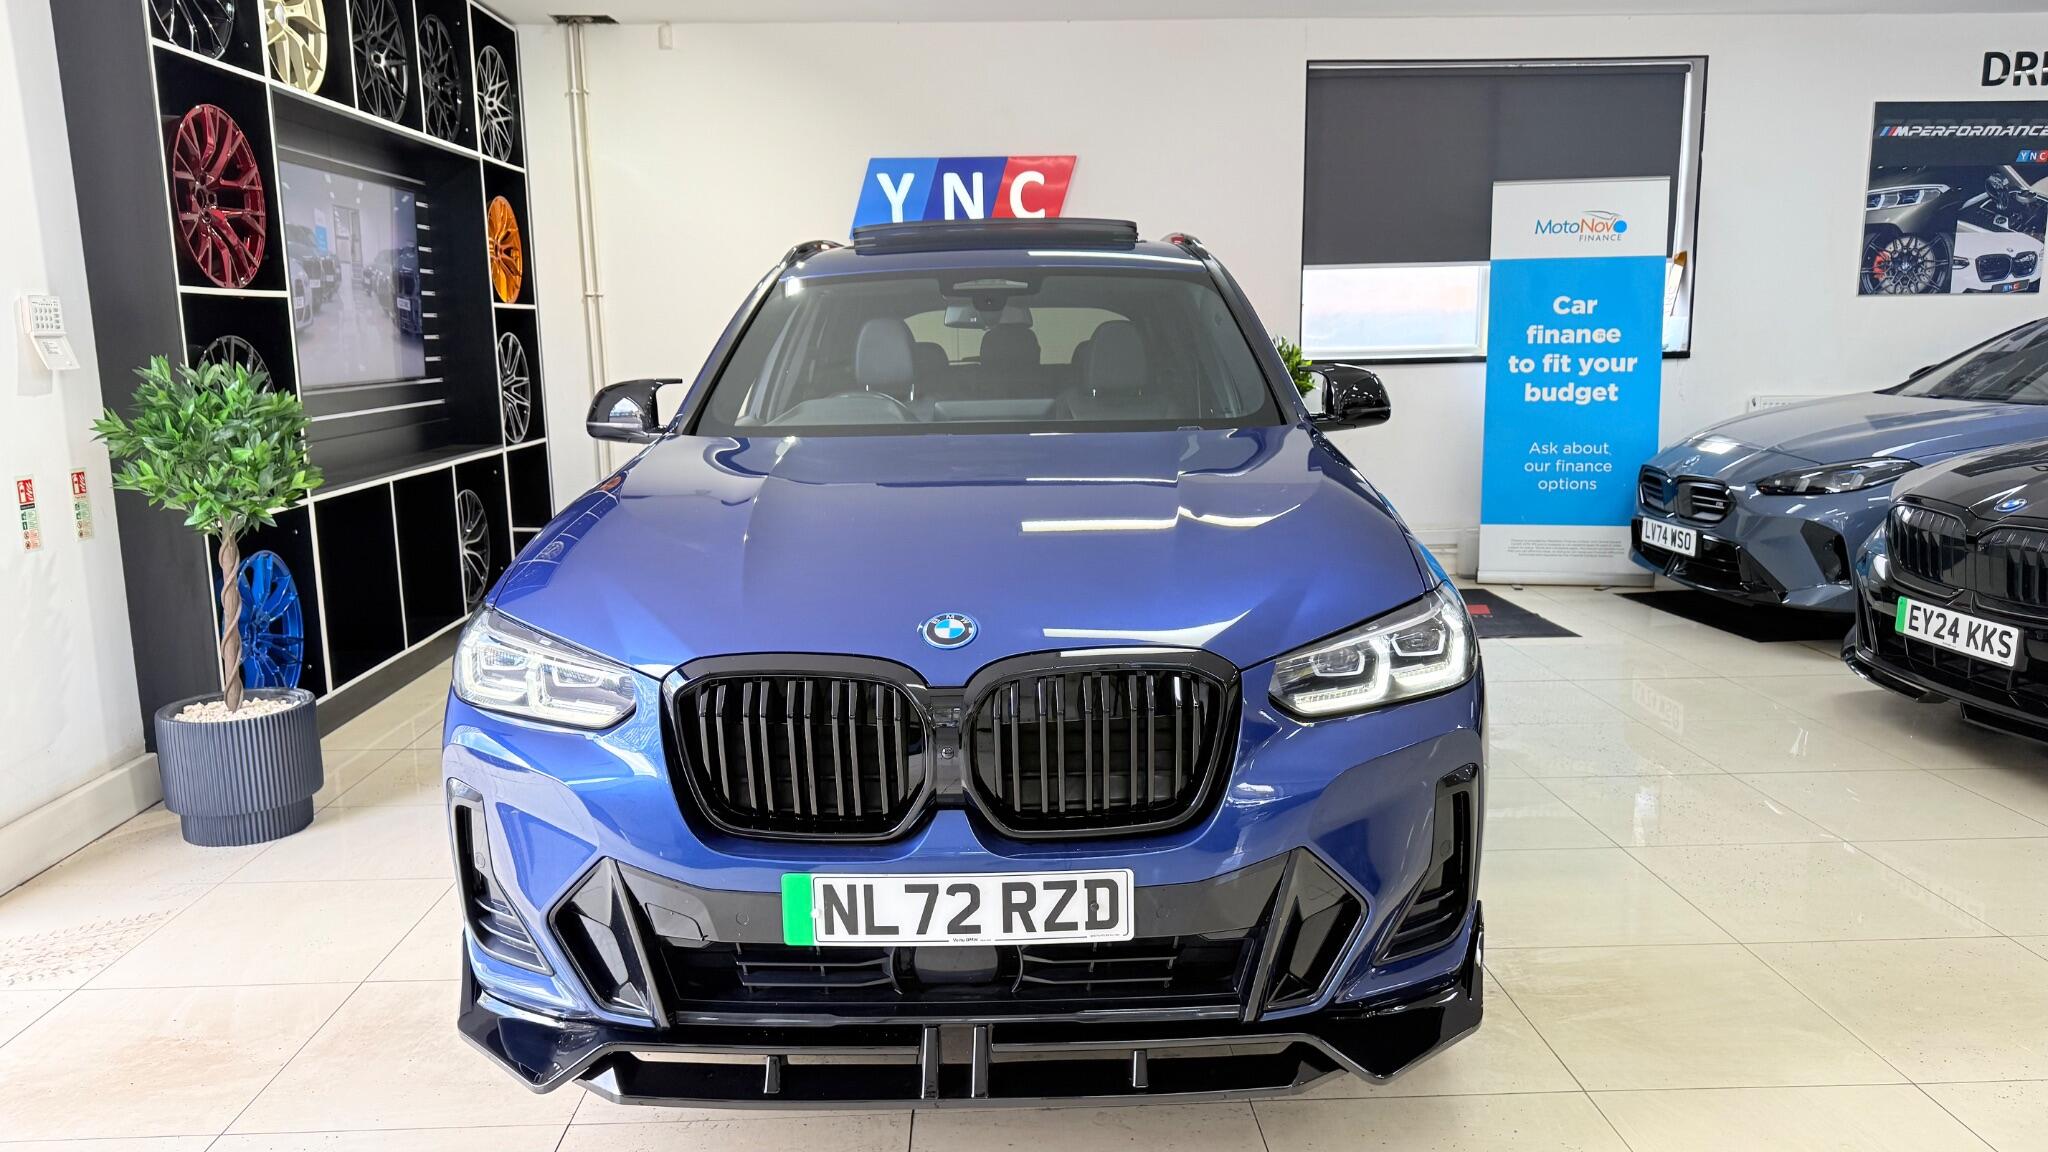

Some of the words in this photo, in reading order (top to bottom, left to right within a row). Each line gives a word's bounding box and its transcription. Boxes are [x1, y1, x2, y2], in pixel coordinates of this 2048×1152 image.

[2020, 151, 2048, 161] YNC
[876, 170, 1046, 223] YNC
[1578, 233, 1624, 243] FINANCE
[1552, 295, 1599, 315] Car
[1526, 325, 1622, 344] finance
[1508, 355, 1535, 373] to
[1542, 354, 1571, 373] fit
[1578, 356, 1638, 376] your
[1524, 382, 1619, 405] budget
[1528, 441, 1558, 455] Ask
[1562, 441, 1610, 455] about
[1524, 460, 1551, 473] our
[1555, 459, 1613, 473] finance
[1537, 478, 1598, 492] options
[1645, 521, 1668, 545] LV74
[1670, 528, 1692, 551] WSO
[1908, 604, 1960, 644] EY24
[1965, 620, 2014, 659] KKS
[822, 882, 982, 936] NL72
[1001, 878, 1120, 934] RZD
